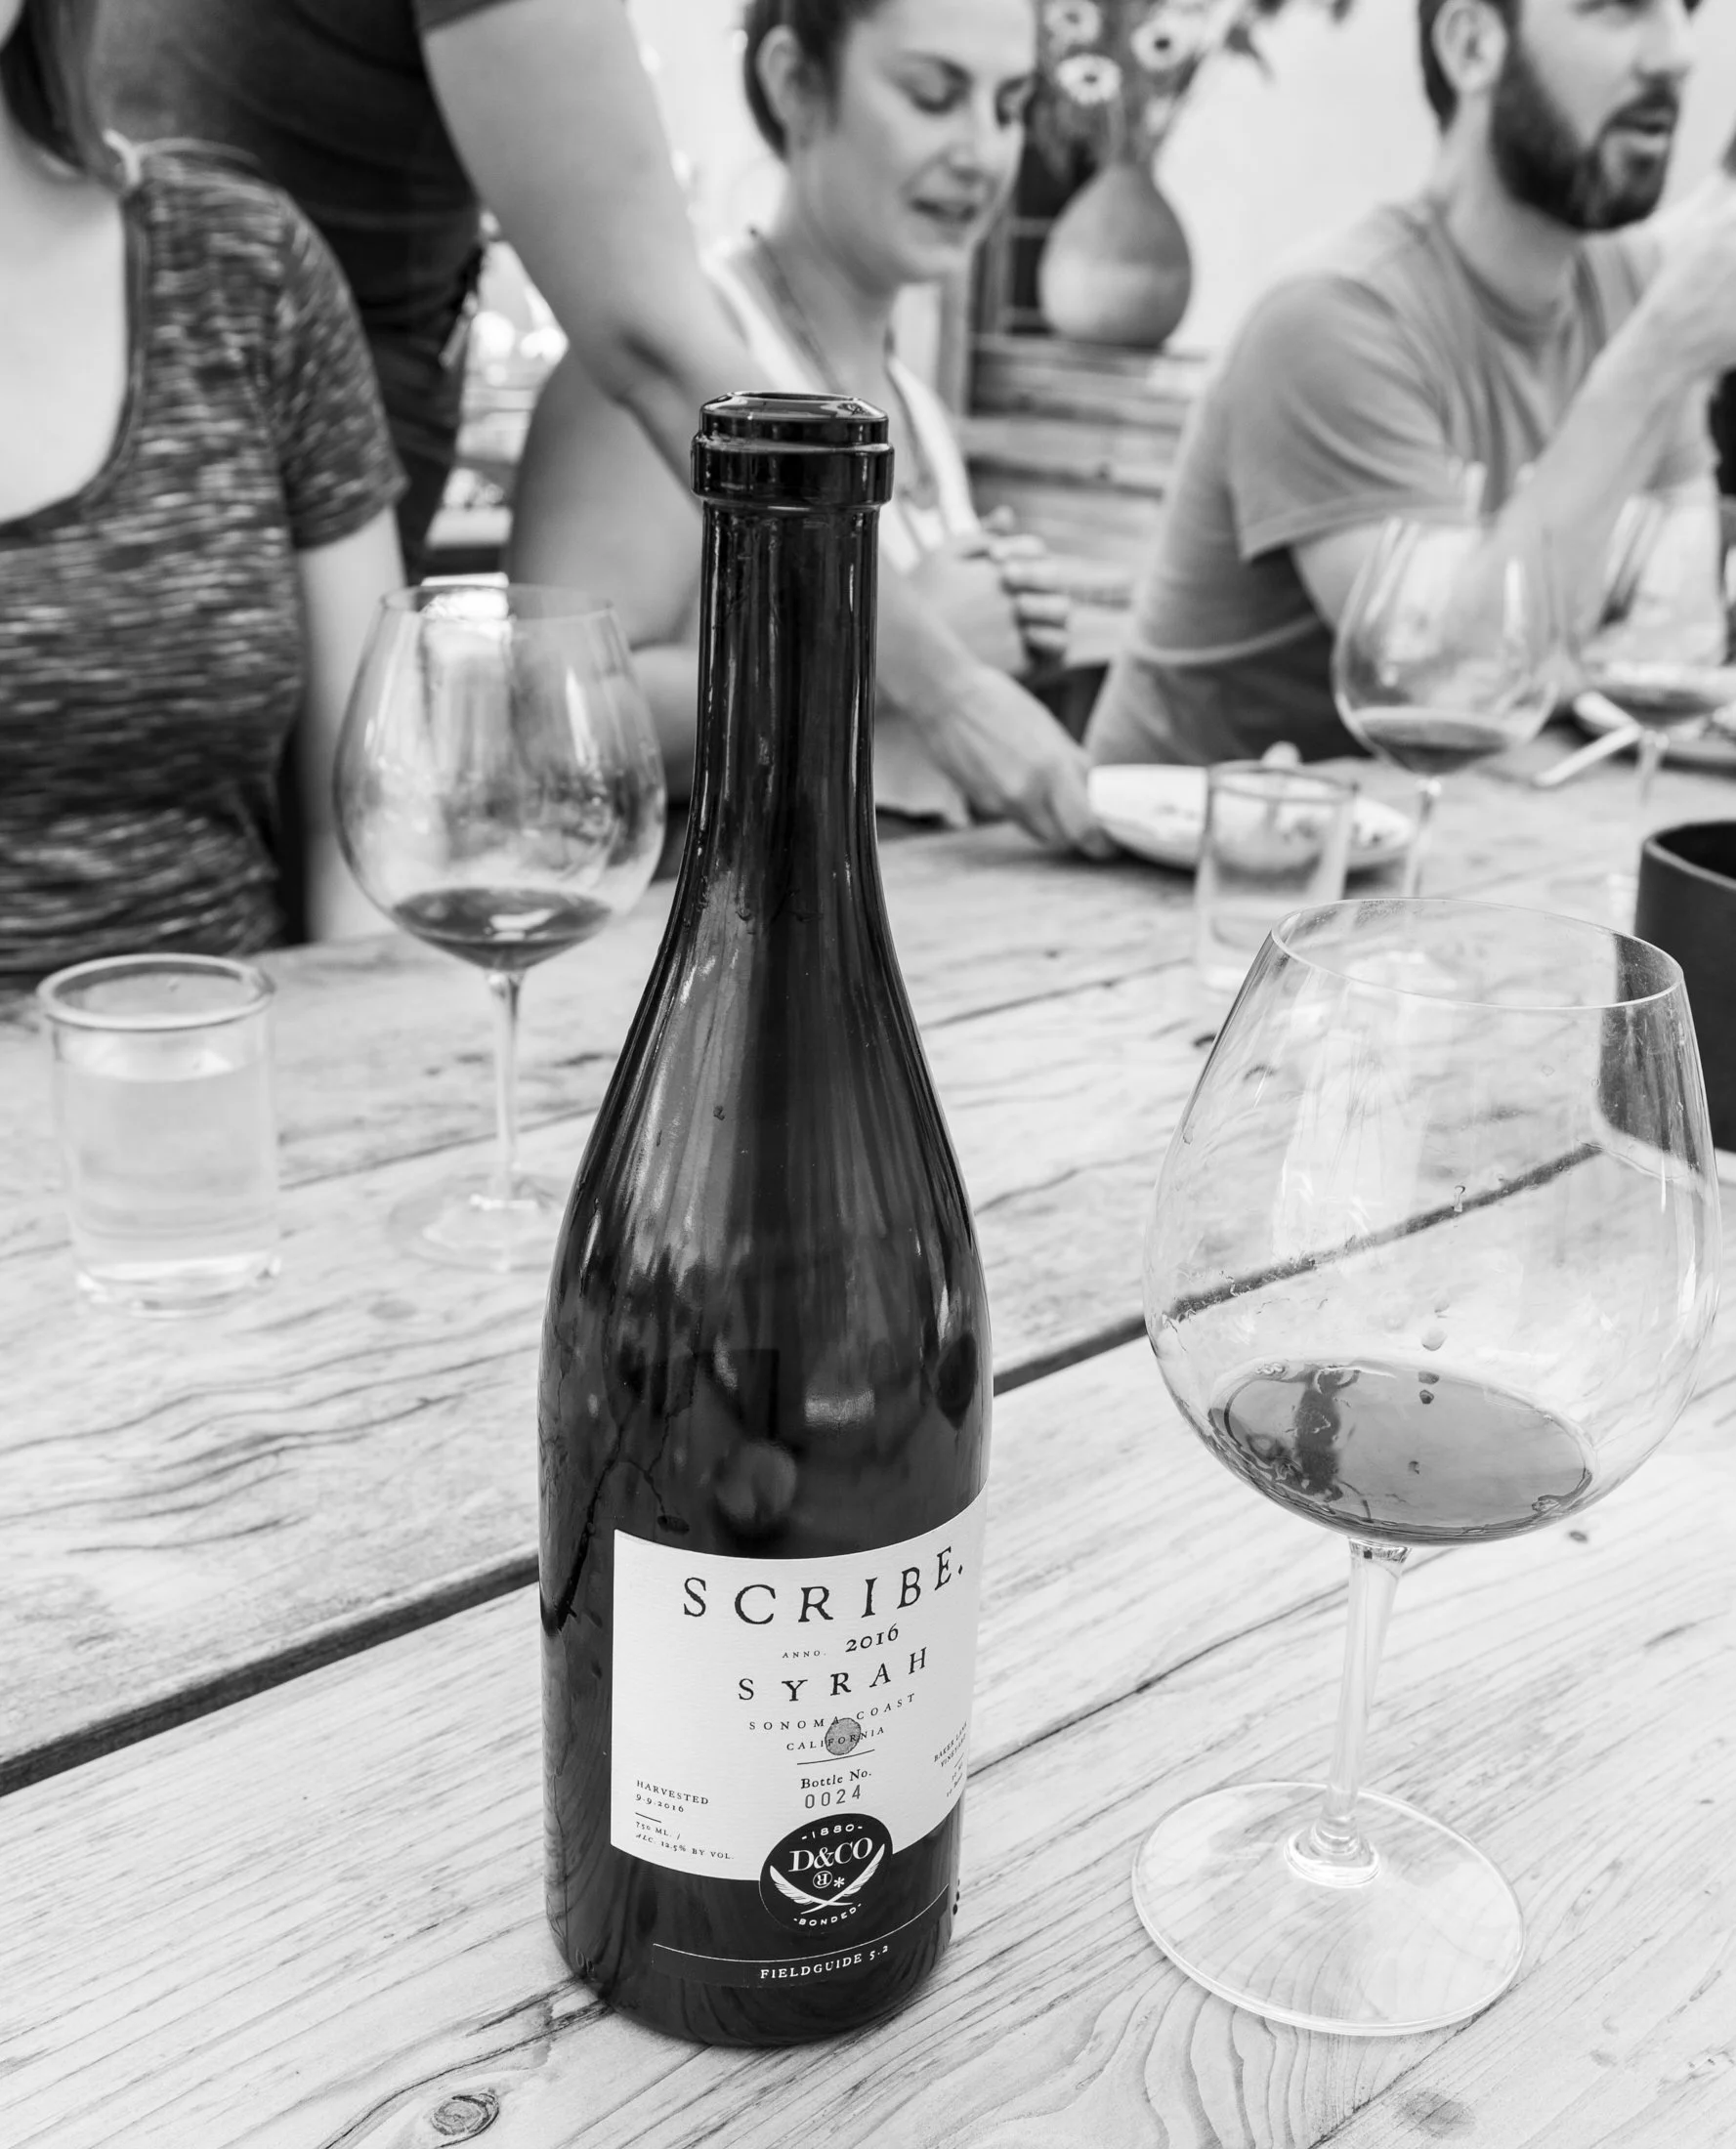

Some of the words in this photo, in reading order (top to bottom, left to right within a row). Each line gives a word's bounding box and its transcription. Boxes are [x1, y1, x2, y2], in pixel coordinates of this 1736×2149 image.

[683, 1546, 963, 1625] SCRIBE.
[845, 1623, 899, 1653] 2016
[738, 1647, 927, 1703] SYRAH
[749, 1716, 839, 1731] SONOMA
[856, 1693, 915, 1721] COAST
[785, 1726, 885, 1751] CALIFORNIA
[636, 1780, 709, 1805] HARVESTED
[800, 1774, 843, 1790] Bottle
[849, 1768, 872, 1783] No.
[804, 1785, 862, 1809] 0024
[787, 1836, 873, 1873] D&CO
[760, 1953, 863, 1979] FIELDGUIDE
